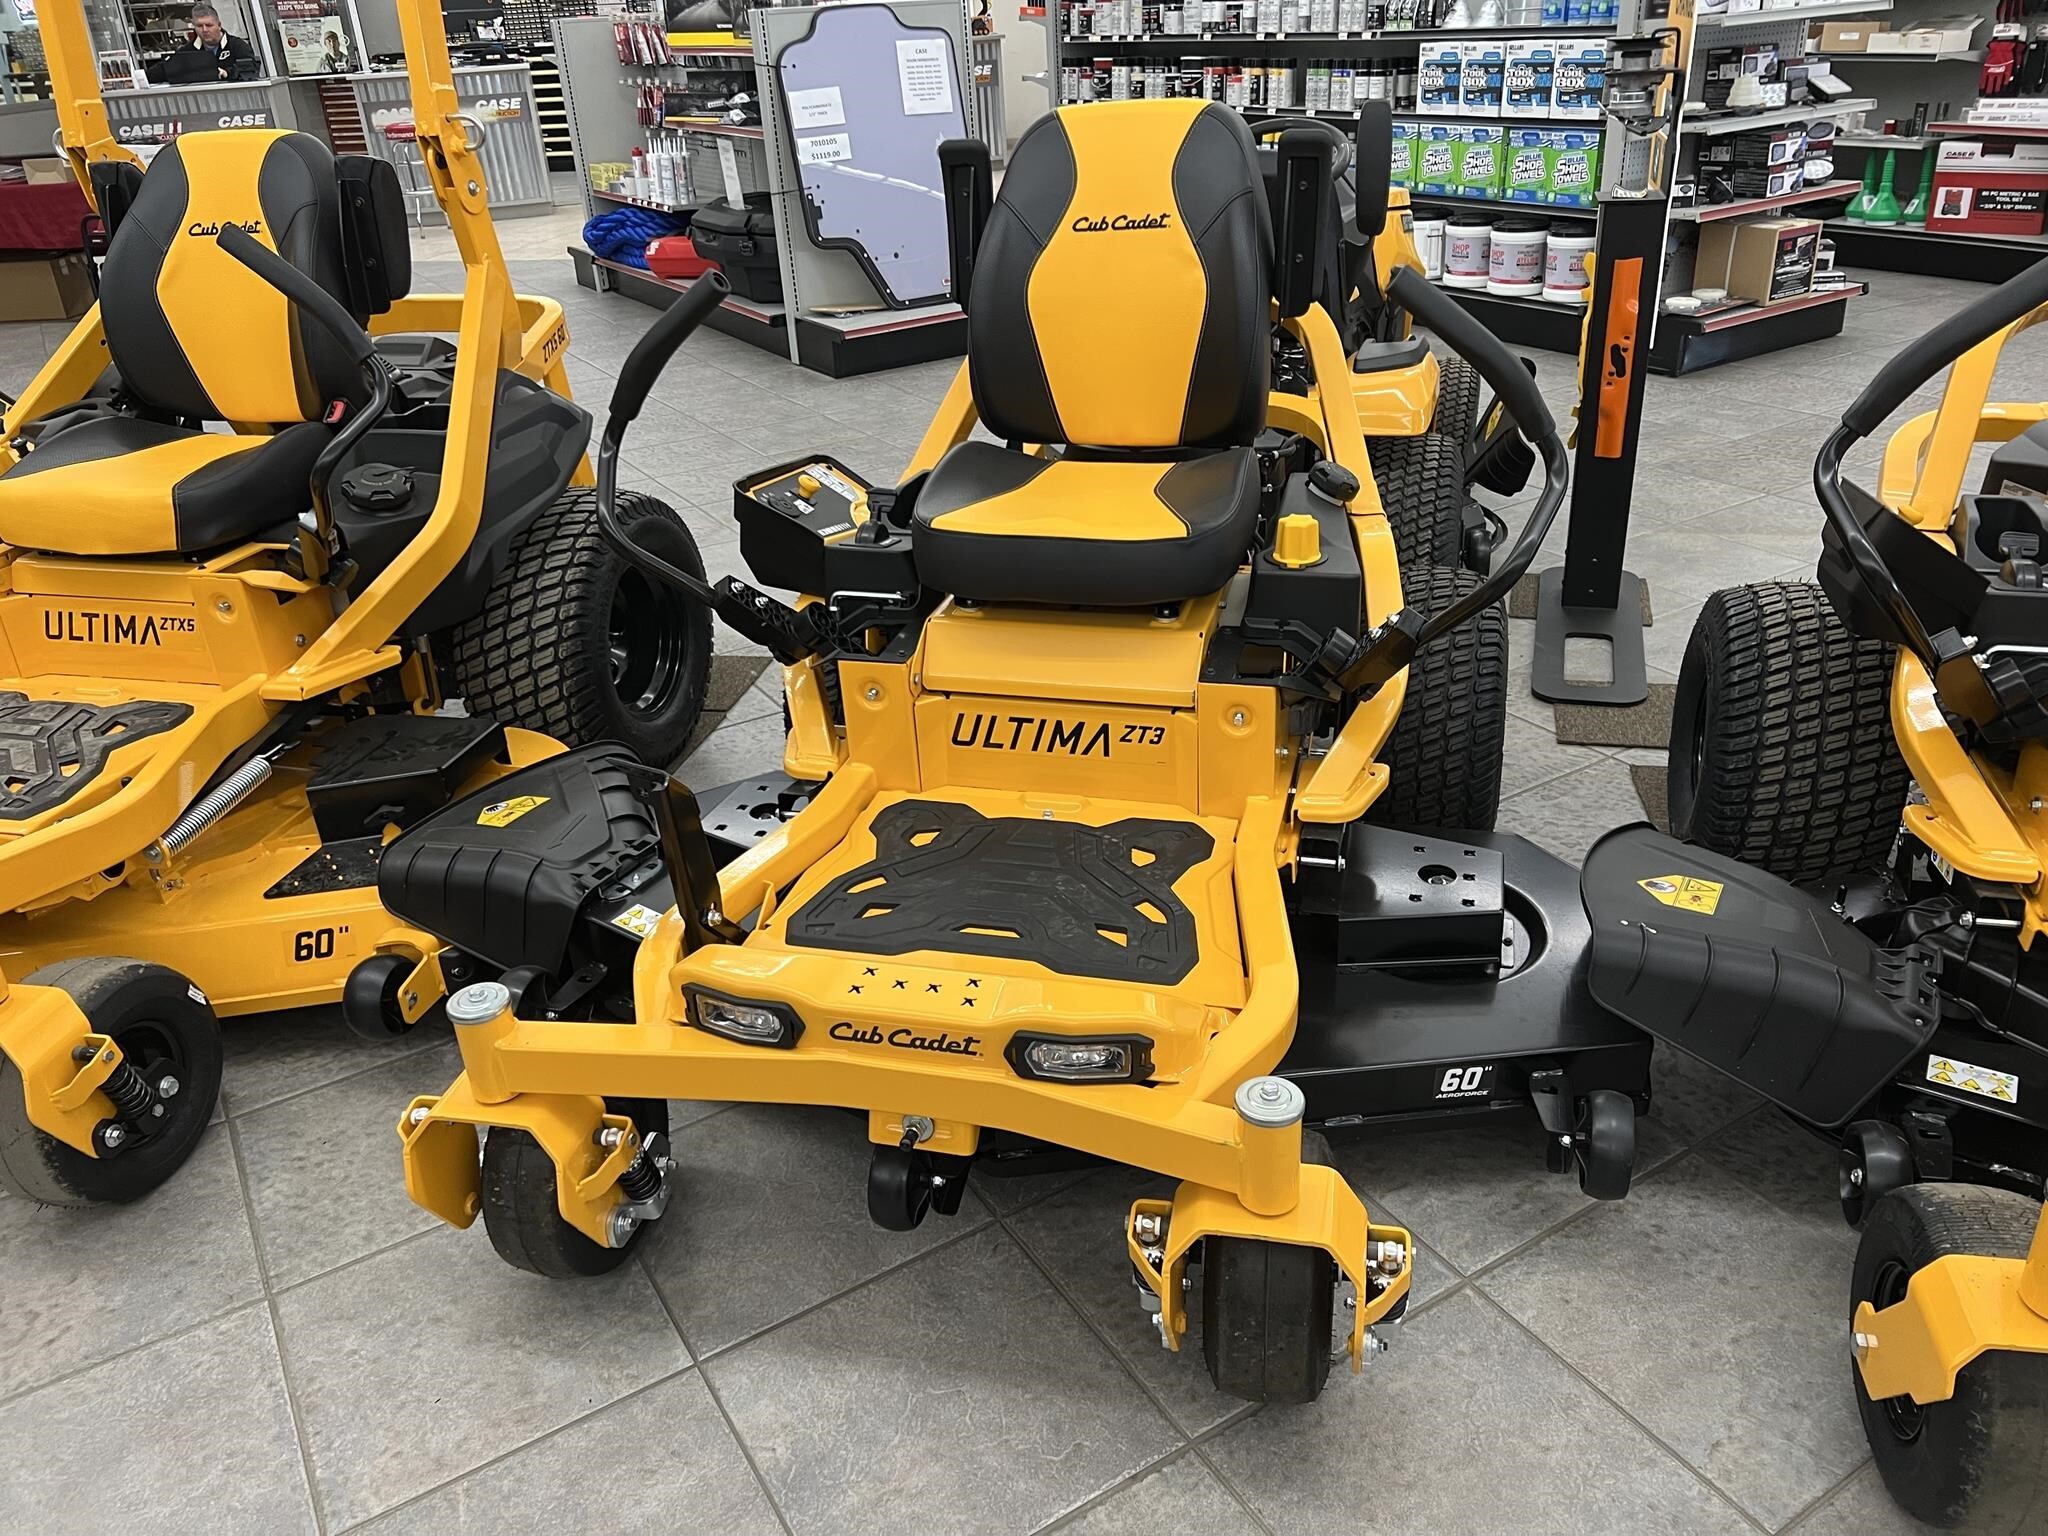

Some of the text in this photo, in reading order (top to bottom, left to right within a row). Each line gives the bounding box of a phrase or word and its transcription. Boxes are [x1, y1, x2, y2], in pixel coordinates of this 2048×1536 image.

[974, 64, 993, 76] SE
[1422, 69, 1442, 78] TOOL
[1463, 69, 1484, 78] TOOL
[1507, 68, 1532, 77] TOOL
[1557, 68, 1582, 78] TOOL
[1420, 77, 1445, 87] BOX
[1462, 77, 1487, 87] BOX
[1506, 76, 1536, 87] BOX
[1555, 77, 1586, 88] BOX
[475, 97, 522, 111] CASE
[218, 113, 267, 128] CASE
[119, 123, 165, 137] CASE
[810, 138, 838, 148] 7010105
[811, 150, 841, 161] $1119.00
[1391, 151, 1409, 162] HOP
[1425, 151, 1451, 165] SHOP
[1467, 152, 1492, 167] SHOP
[1474, 149, 1492, 157] BLUE
[1525, 153, 1542, 161] BLUE
[1391, 160, 1411, 169] WELS
[1515, 156, 1543, 171] SHOP
[1567, 156, 1586, 164] BLUE
[1422, 161, 1452, 176] TOWELS
[1463, 163, 1494, 179] TOWELS
[1557, 159, 1587, 175] SHOP
[1511, 169, 1545, 184] TOWELS
[1552, 172, 1589, 189] TOWELS
[188, 221, 219, 237] Cub
[1072, 213, 1171, 232] Cub Cadet
[1452, 244, 1470, 253] SHOP
[44, 610, 195, 646] ULTIMA ZTX5
[951, 712, 1166, 758] ULTIMA ZT3
[294, 925, 349, 962] 60"
[829, 1022, 981, 1057] Cub Cadet
[1440, 1065, 1493, 1092] 60"
[1435, 1089, 1490, 1099] AEROFORCE
